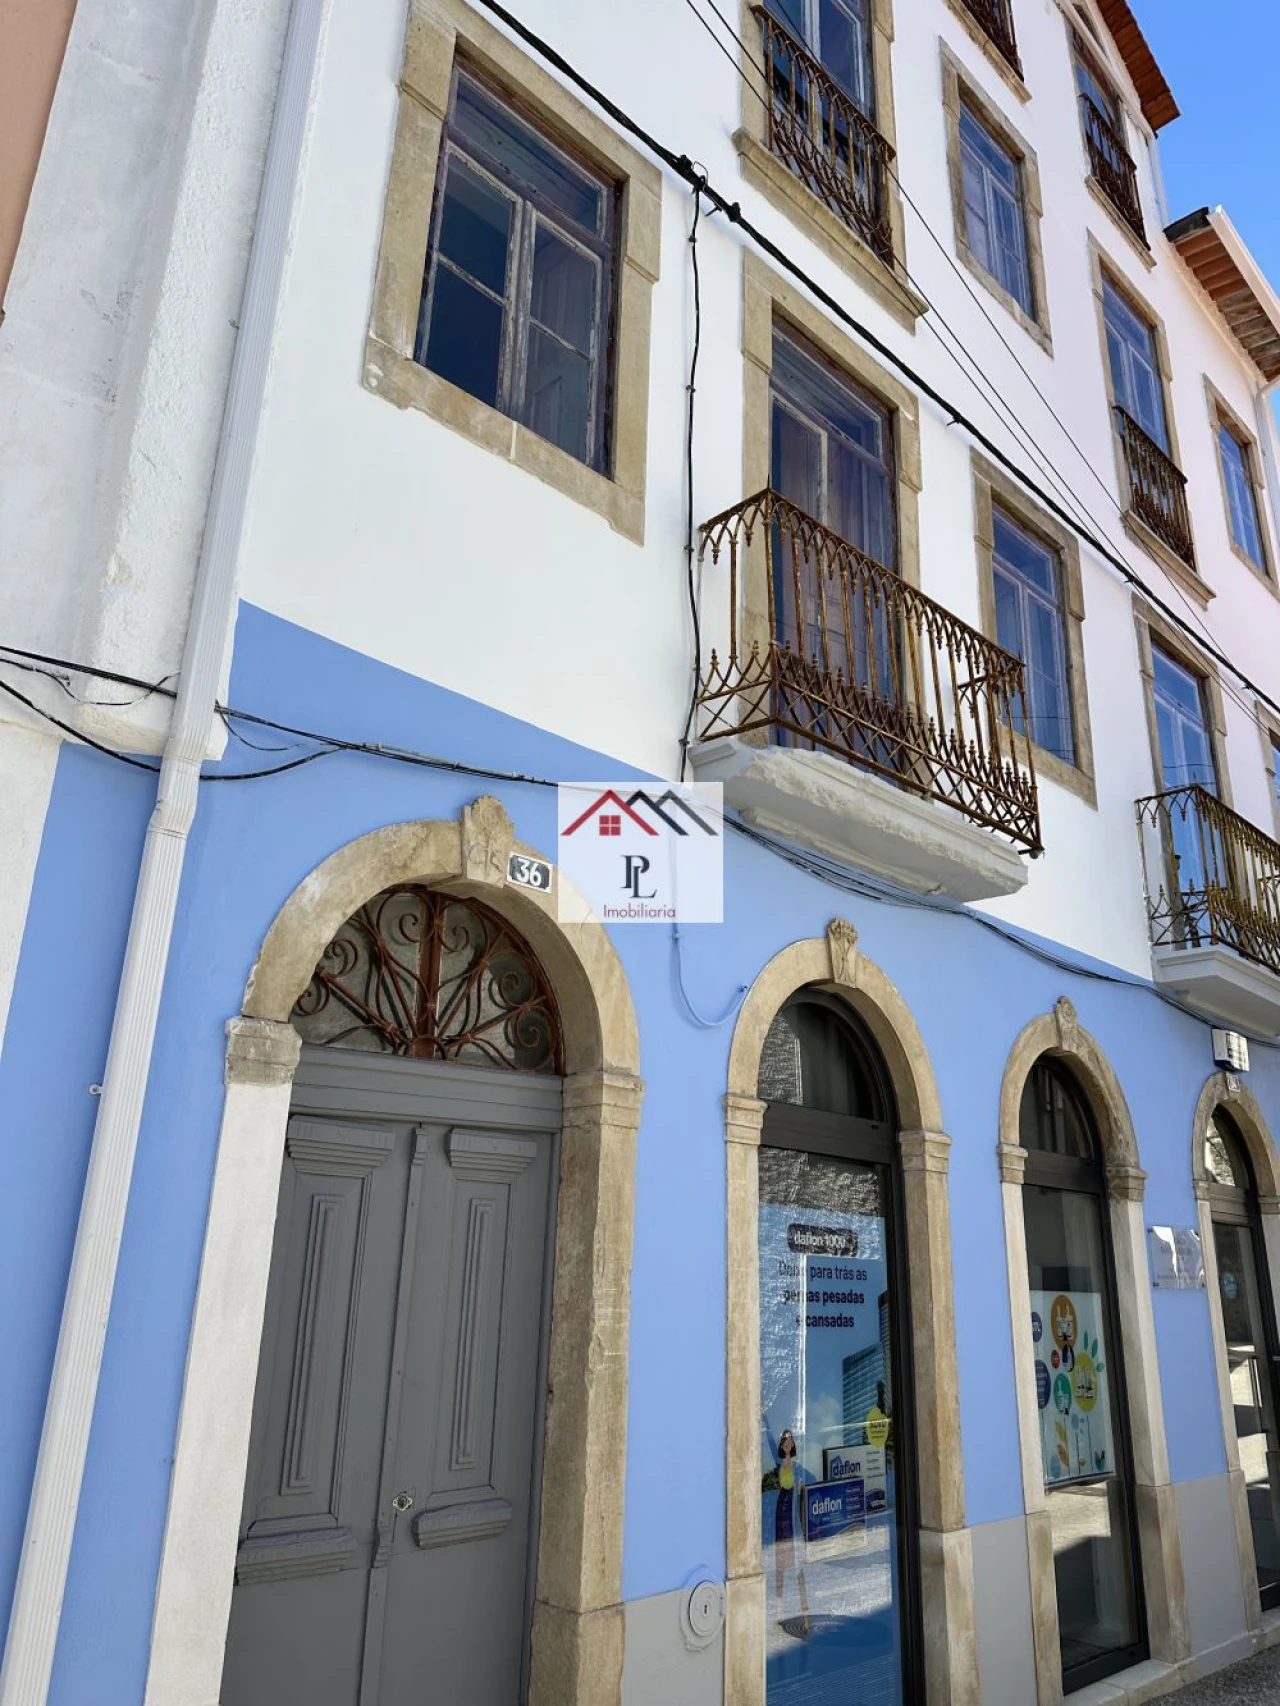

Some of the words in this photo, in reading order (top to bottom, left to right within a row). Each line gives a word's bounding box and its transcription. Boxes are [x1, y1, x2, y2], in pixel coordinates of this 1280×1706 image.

[516, 857, 542, 887] 36
[794, 1231, 823, 1246] daflon
[810, 1264, 833, 1281] para
[835, 1263, 854, 1280] trás
[855, 1268, 868, 1281] as
[822, 1289, 865, 1307] pesadas
[805, 1313, 855, 1328] cansadas
[832, 1460, 861, 1477] daflon
[812, 1496, 842, 1516] daflon
